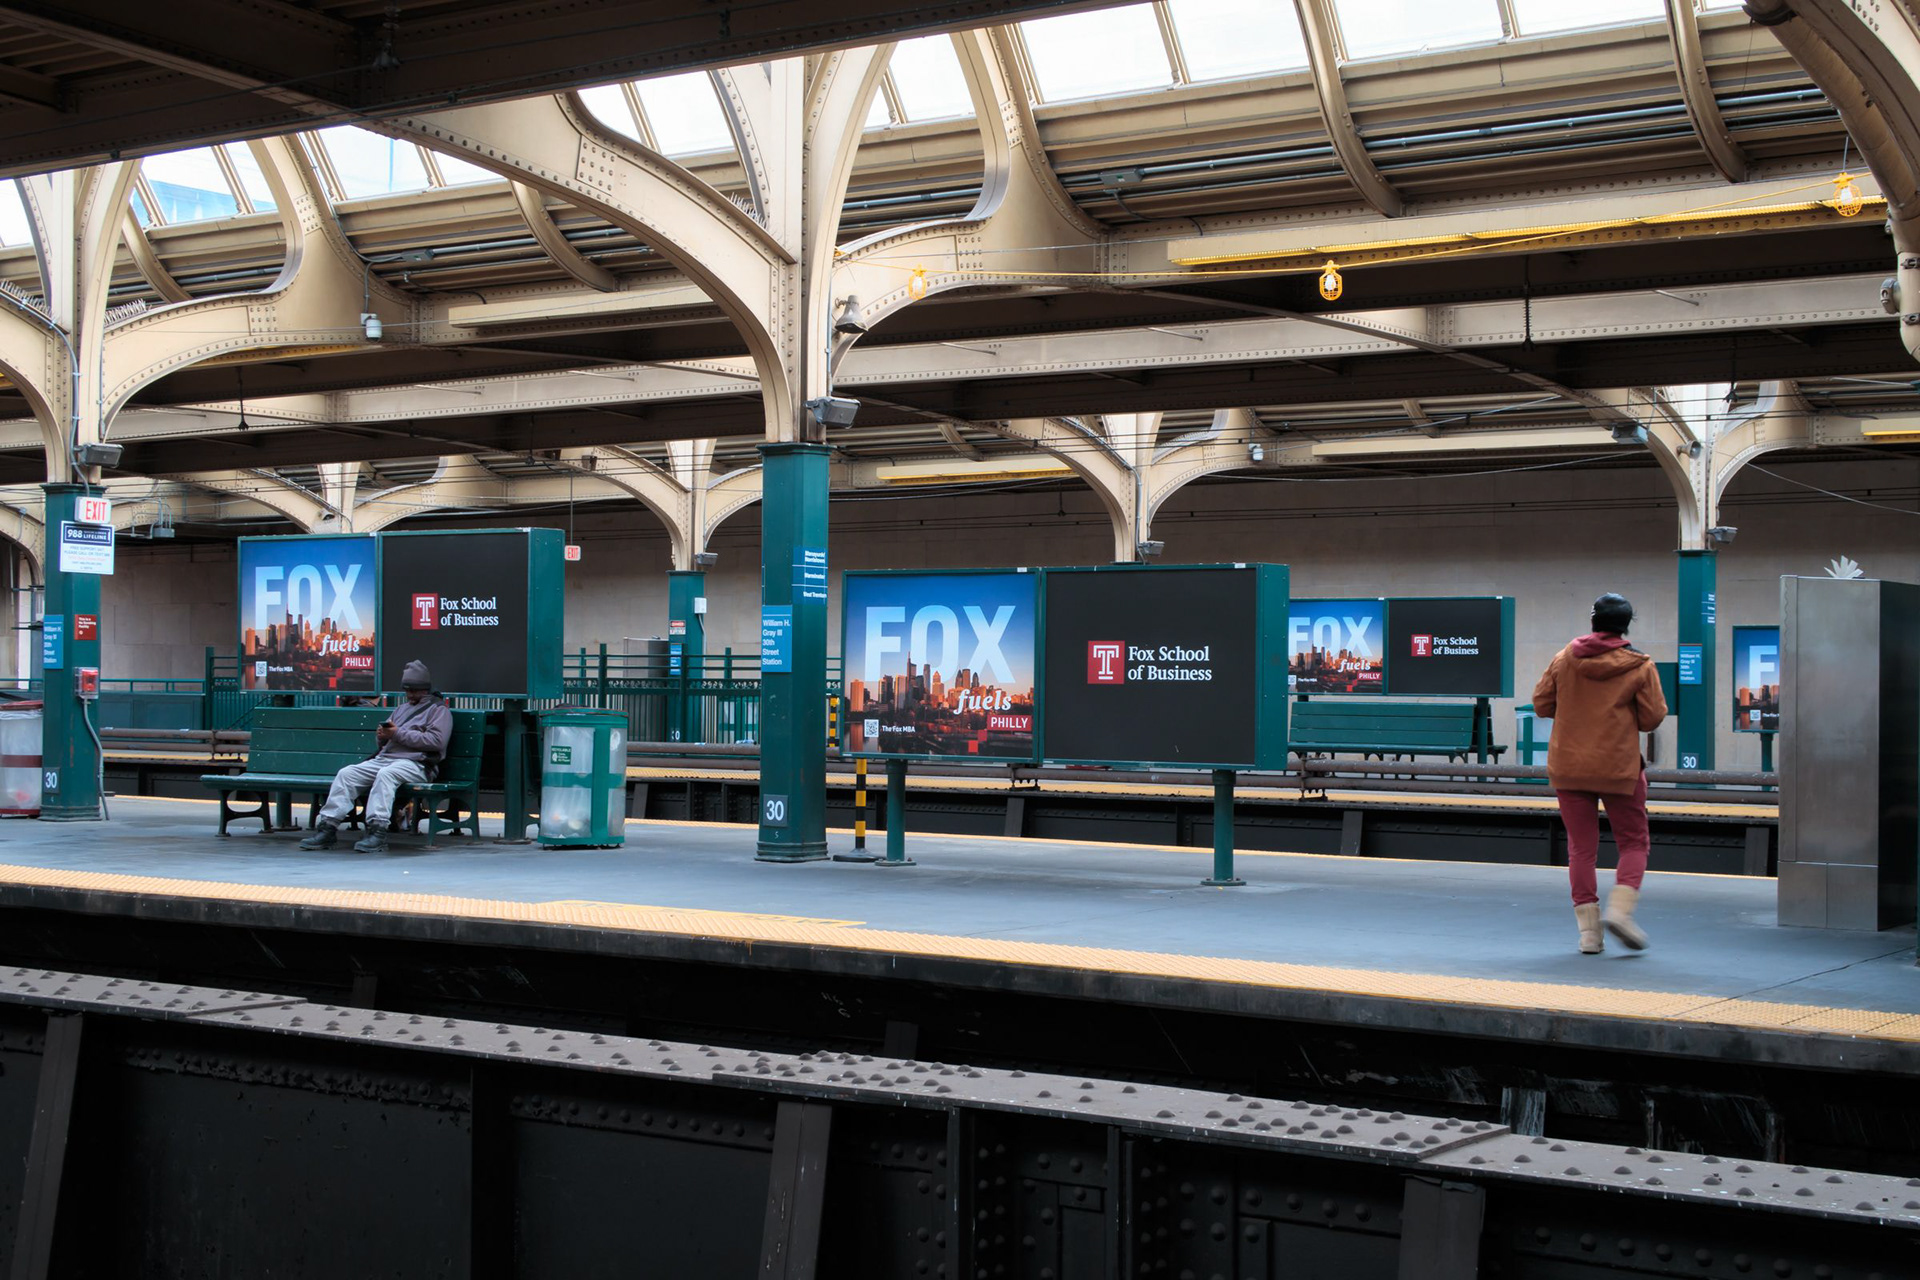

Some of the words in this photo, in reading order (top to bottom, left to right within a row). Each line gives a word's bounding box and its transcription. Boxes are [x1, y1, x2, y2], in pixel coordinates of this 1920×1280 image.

[85, 500, 107, 521] EXIT
[67, 529, 83, 538] 988
[567, 547, 579, 559] EXIT
[255, 564, 363, 630] FOX
[440, 597, 459, 610] Fox
[461, 596, 497, 610] School
[440, 612, 453, 626] of
[454, 612, 499, 626] Business
[763, 629, 775, 638] Gray
[1288, 616, 1373, 658] FOX
[318, 634, 361, 657] fuels
[865, 605, 1016, 683] FOX
[1433, 636, 1448, 646] Fox
[1449, 636, 1477, 646] School
[763, 648, 779, 656] Street
[1128, 646, 1155, 661] Fox
[1158, 645, 1210, 661] School
[1432, 646, 1443, 656] of
[1444, 646, 1479, 656] Business
[344, 656, 373, 667] PHILLY
[763, 657, 783, 665] Station
[1337, 658, 1371, 673] fuels
[1127, 664, 1145, 681] of
[1147, 664, 1213, 681] Business
[1358, 672, 1381, 680] PHILLY
[953, 688, 1012, 715] fuels
[903, 725, 916, 733] MBA
[990, 716, 1029, 729] PHILLY
[1682, 755, 1697, 769] 30
[45, 771, 58, 789] 30
[766, 799, 785, 821] 30
